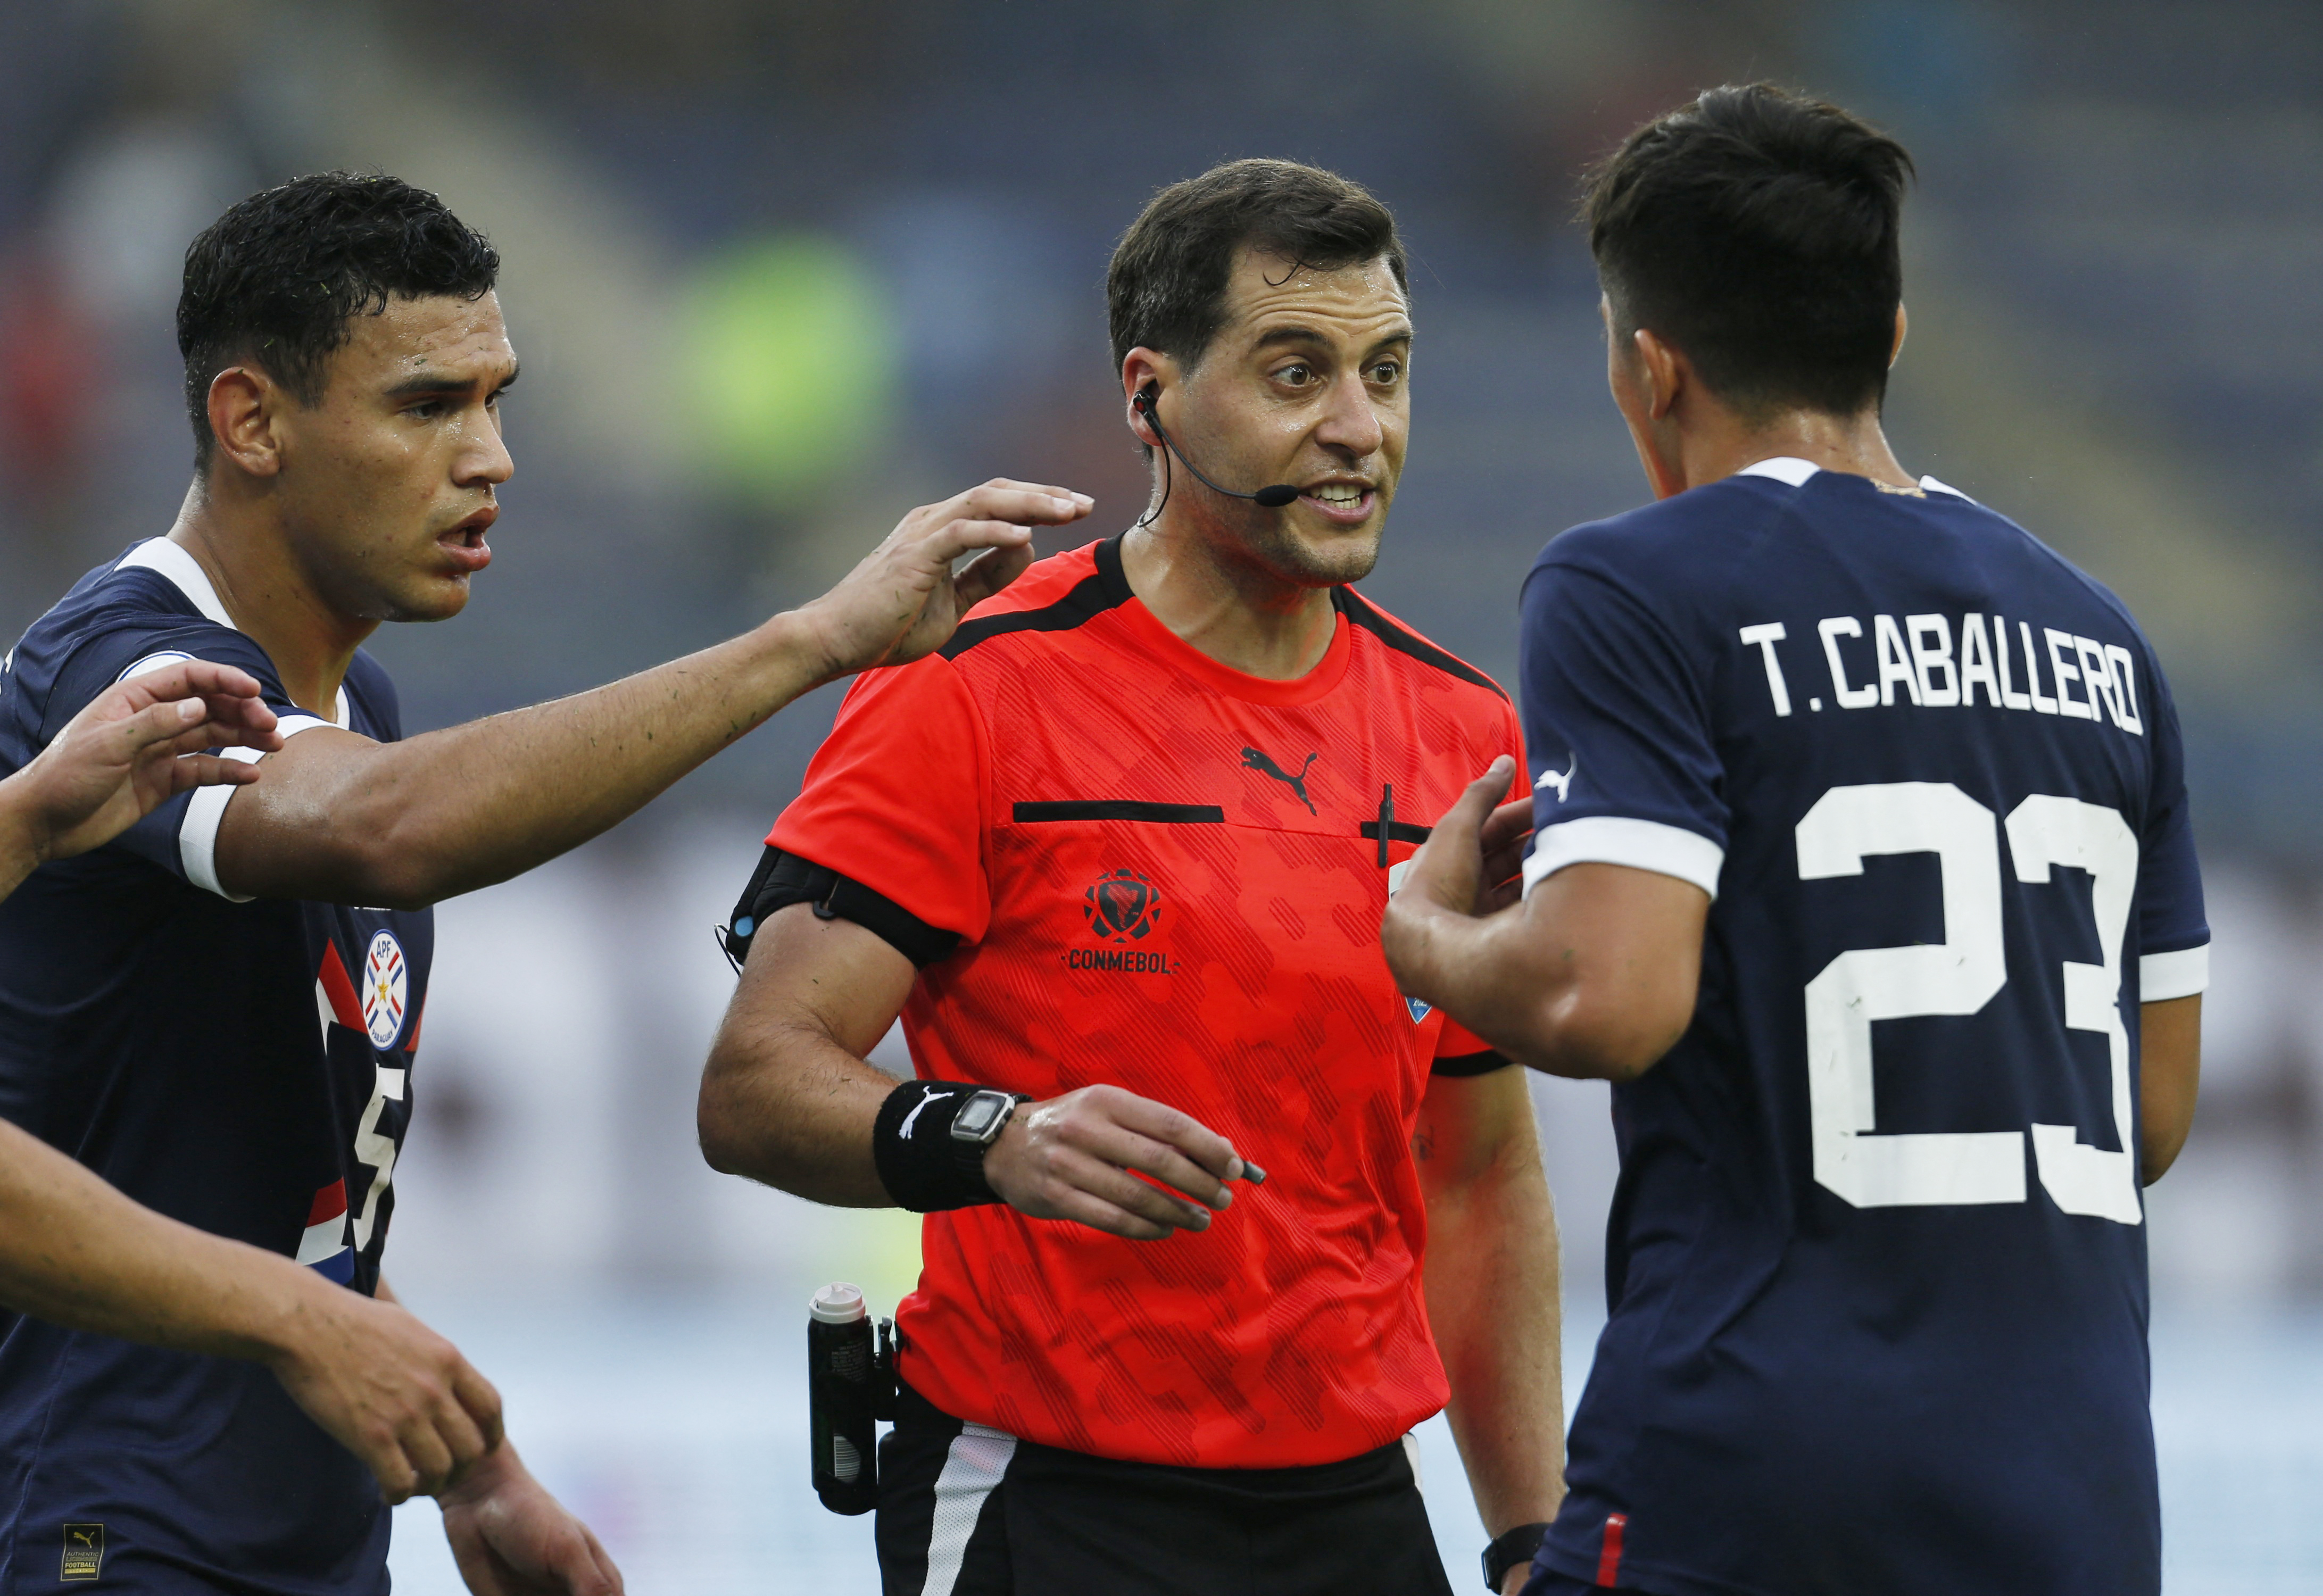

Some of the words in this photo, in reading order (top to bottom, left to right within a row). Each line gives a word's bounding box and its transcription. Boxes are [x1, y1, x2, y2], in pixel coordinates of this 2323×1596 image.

[376, 940, 391, 958] APF
[1069, 949, 1171, 975] CONMEBOL
[1413, 998, 1427, 1007] 202
[1795, 782, 2143, 1226] 23
[372, 1028, 393, 1043] PARAGUAY
[354, 1062, 405, 1252] 5
